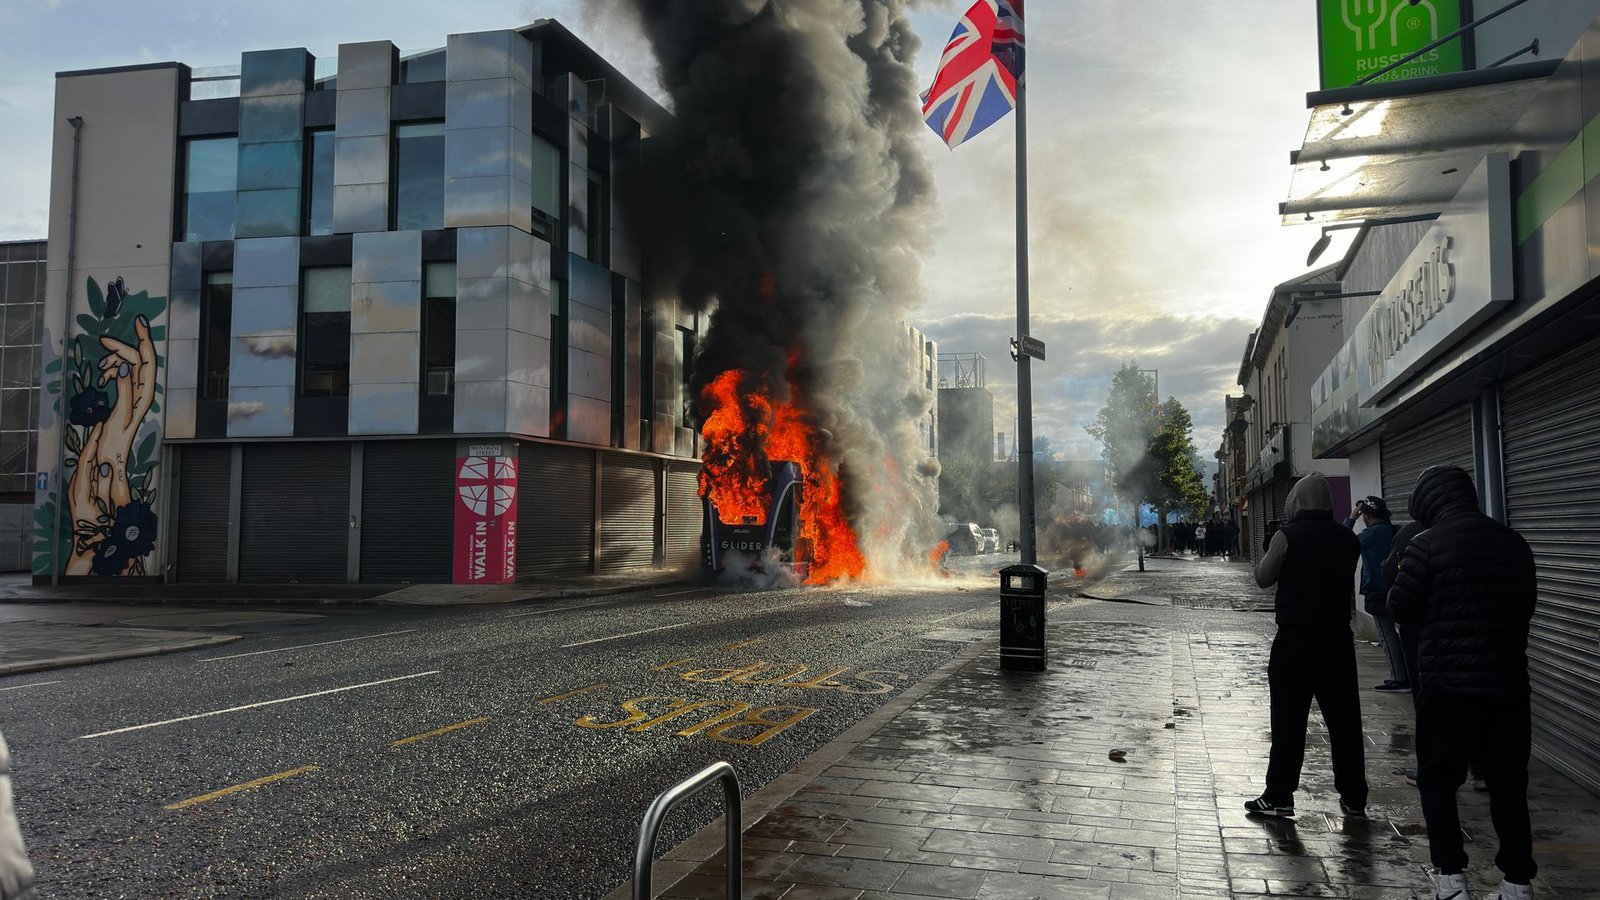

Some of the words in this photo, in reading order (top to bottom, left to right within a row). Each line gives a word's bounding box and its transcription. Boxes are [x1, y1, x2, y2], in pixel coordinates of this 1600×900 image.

[1357, 72, 1389, 83] FOD
[1401, 65, 1439, 79] DRINK
[475, 521, 487, 536] IN
[507, 521, 515, 536] IN
[506, 538, 515, 579] WALK
[721, 541, 762, 550] GLIDER
[474, 538, 487, 580] WALK
[681, 660, 908, 695] STOP
[574, 696, 820, 746] BUS
